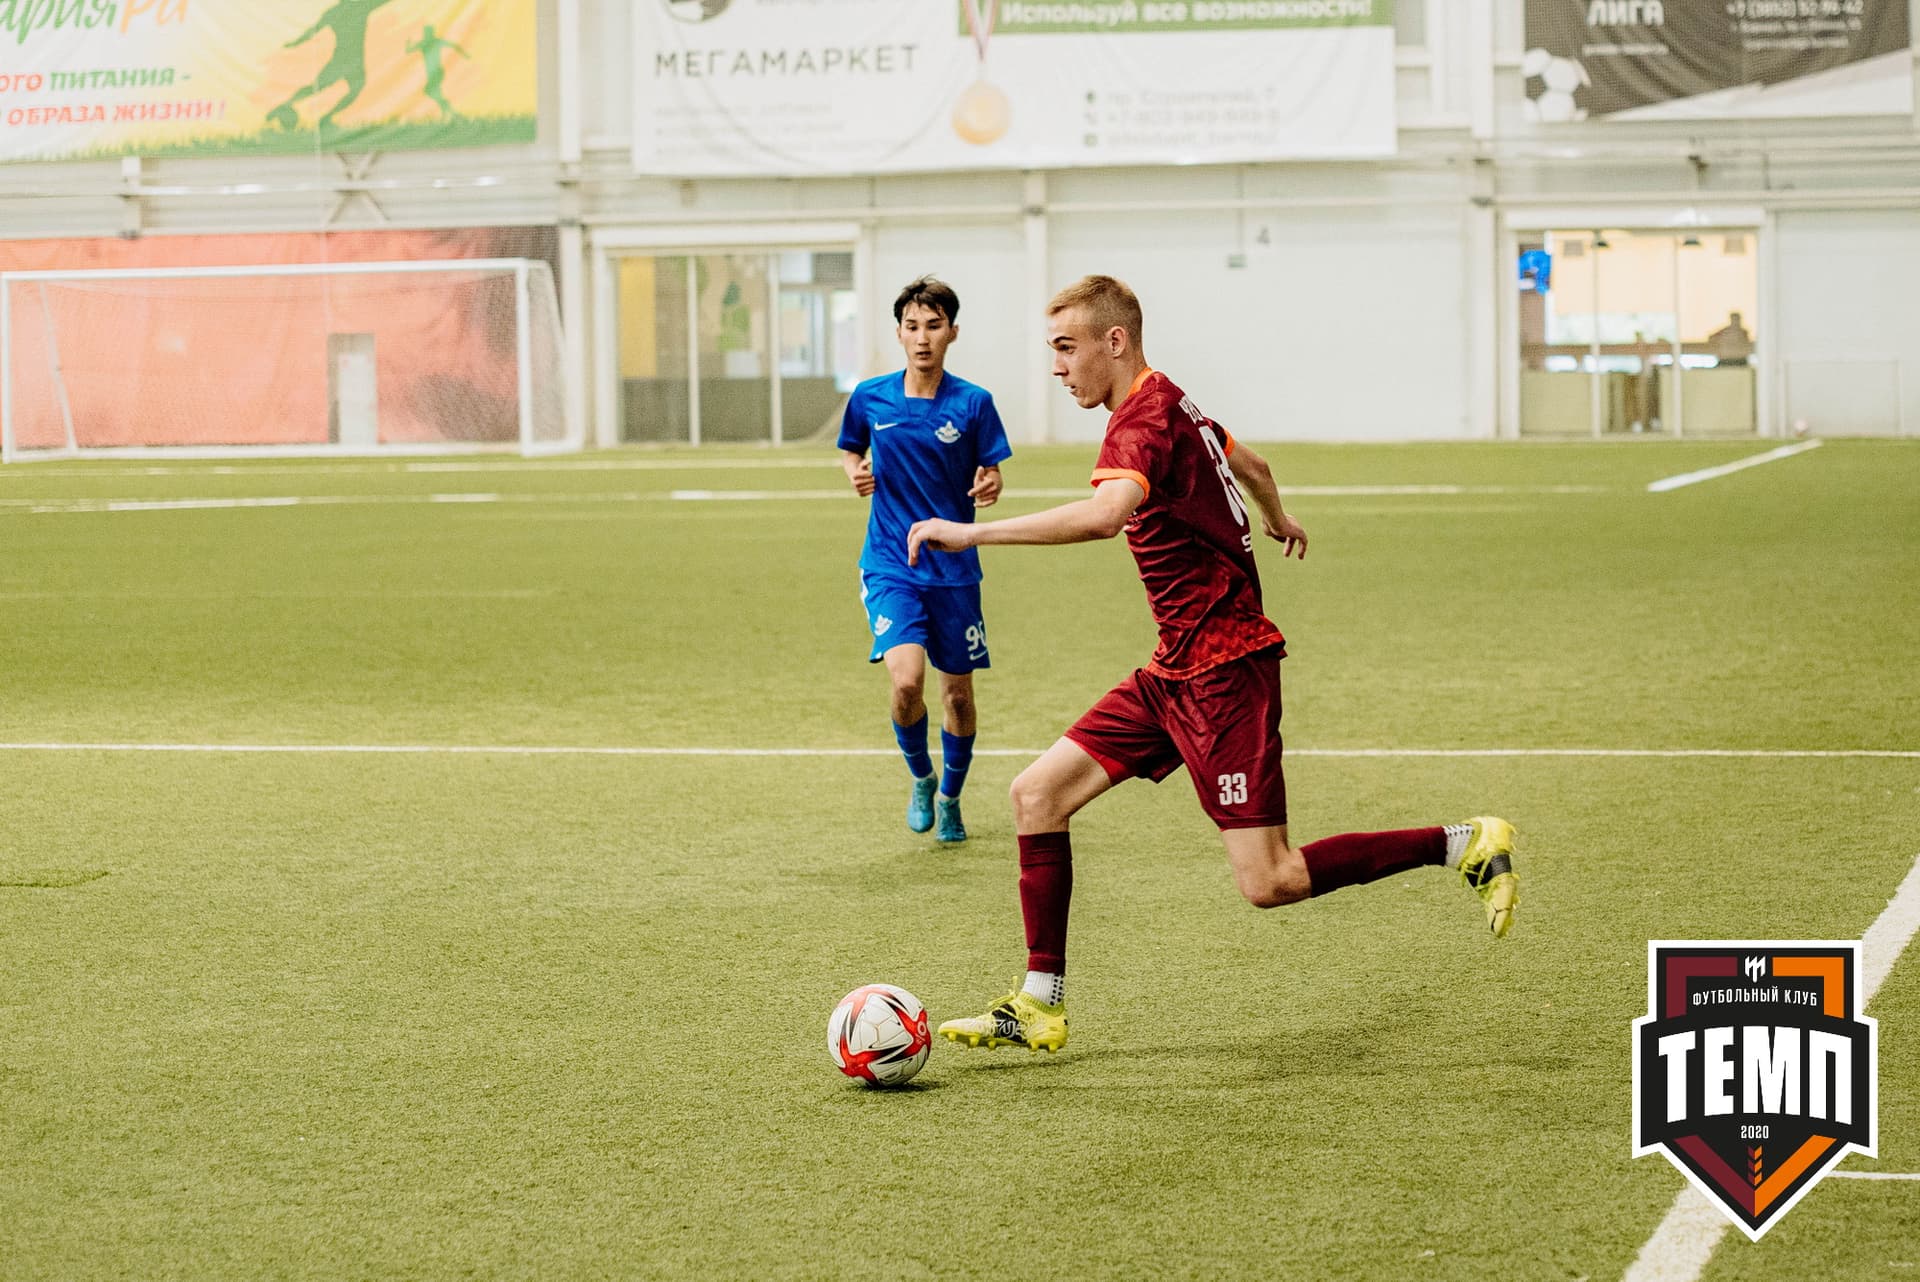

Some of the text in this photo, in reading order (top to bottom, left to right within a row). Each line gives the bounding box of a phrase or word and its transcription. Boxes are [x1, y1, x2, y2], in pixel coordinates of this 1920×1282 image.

[1000, 1, 1137, 27] Используй
[1142, 2, 1188, 23] все
[1586, 0, 1666, 27] ЛИГА
[654, 44, 919, 77] МЕГАМАРКЕТ
[50, 67, 176, 91] ПИТАНИЯ
[7, 104, 105, 126] ОБРАЗА
[1217, 773, 1248, 805] 33
